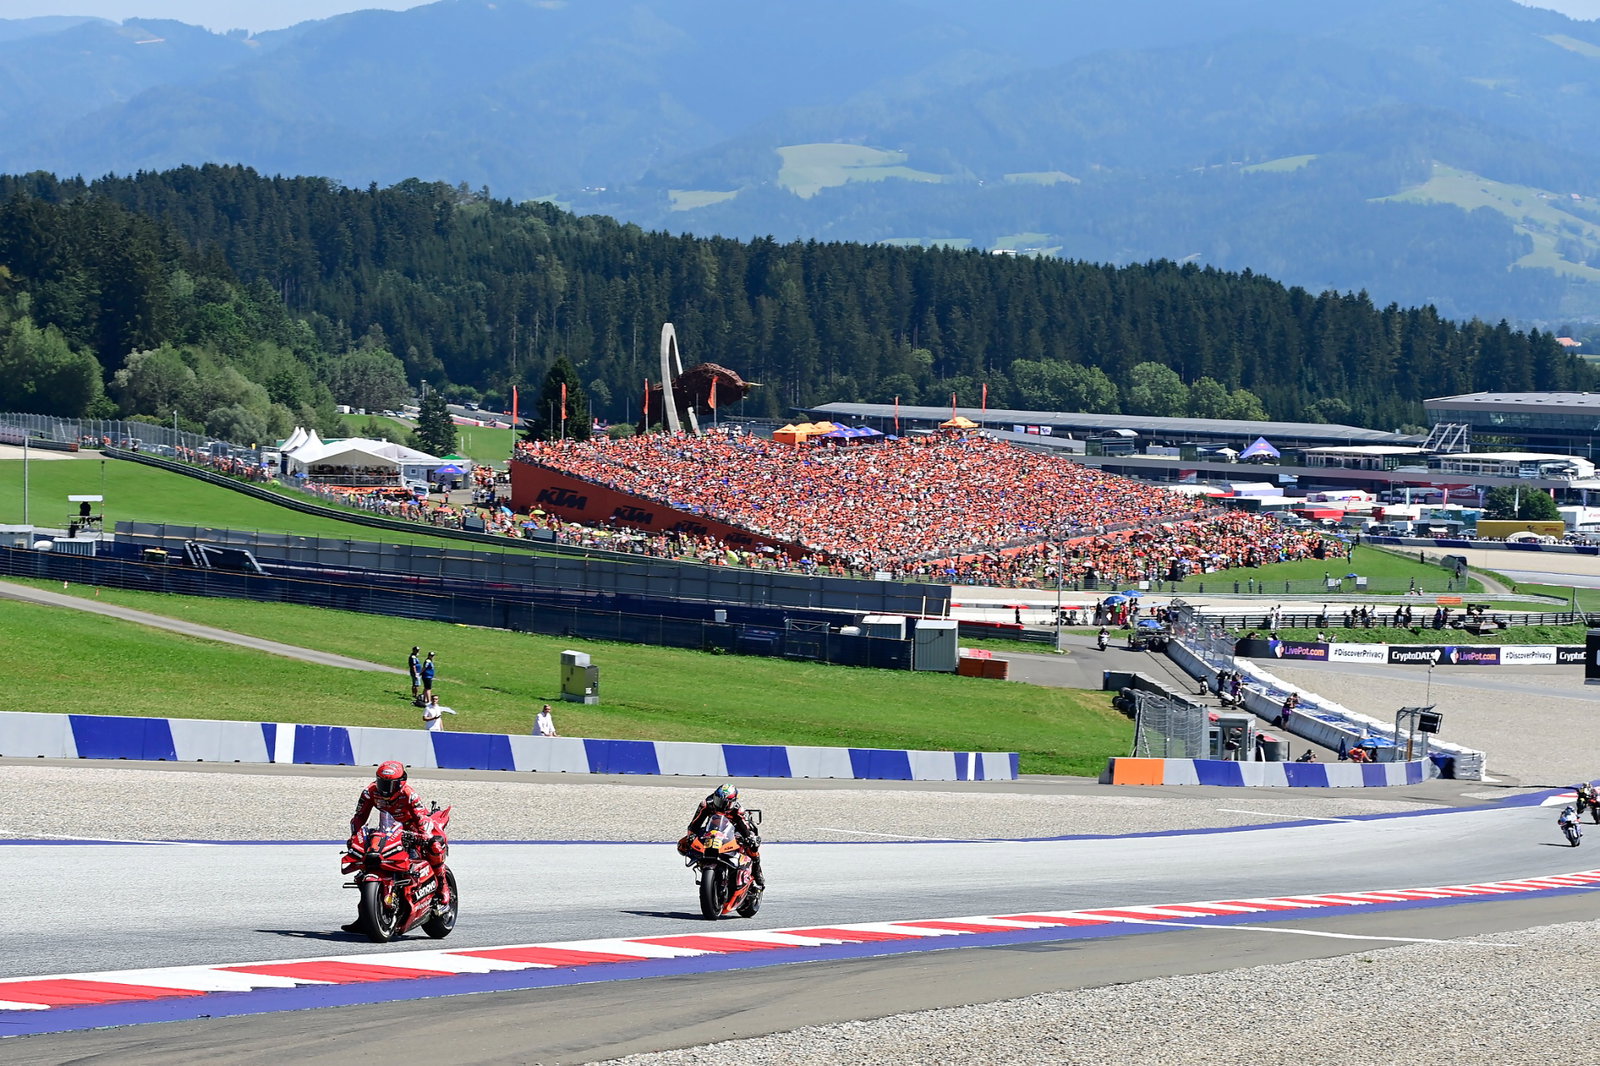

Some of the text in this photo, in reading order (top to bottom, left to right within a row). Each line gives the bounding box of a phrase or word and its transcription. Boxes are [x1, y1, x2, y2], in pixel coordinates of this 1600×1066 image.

[536, 487, 588, 510] KTM
[613, 505, 654, 525] KTM
[1284, 646, 1325, 657] LivePot.com
[1333, 648, 1384, 660] #DiscoverPrivacy
[1459, 652, 1497, 661] LivePot.com
[1505, 651, 1552, 661] #DiscoverPrivacy
[415, 880, 436, 900] Lenovo
